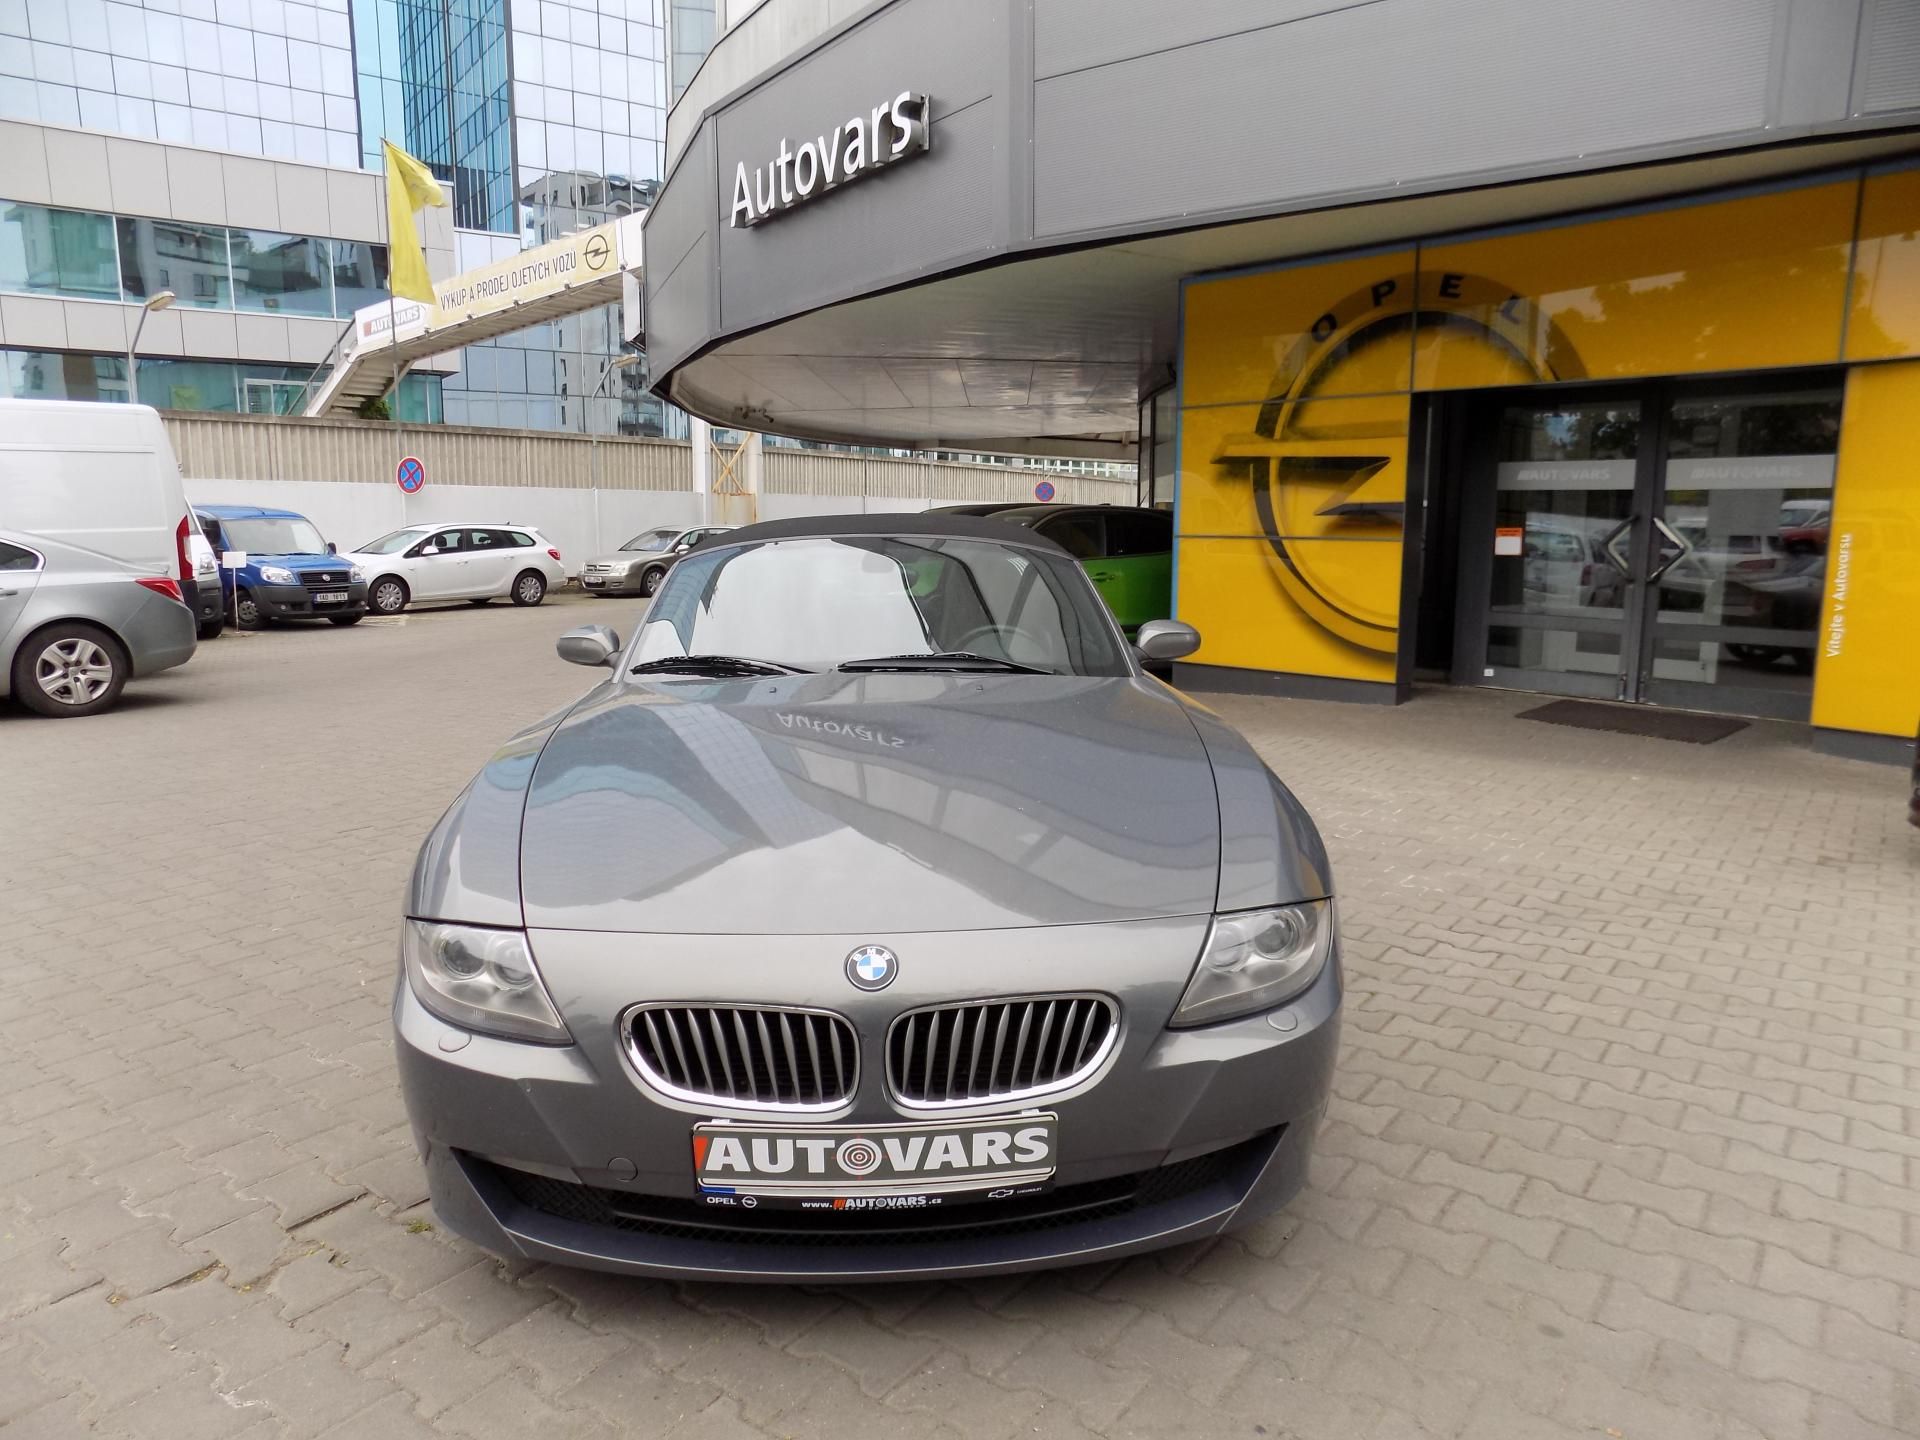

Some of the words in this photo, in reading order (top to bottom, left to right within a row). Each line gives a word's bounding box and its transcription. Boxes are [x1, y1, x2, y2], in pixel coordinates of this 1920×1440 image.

[730, 91, 912, 228] Autovars
[440, 288, 466, 311] VÝKUP
[469, 286, 475, 302] A
[477, 274, 509, 299] PRODEJ
[512, 260, 550, 288] OJETÝCH
[1311, 273, 1521, 342] OPEL
[1832, 533, 1852, 601] Autovarsu
[853, 947, 892, 962] BMW
[705, 1127, 1049, 1175] AUTOVARS
[706, 1196, 737, 1205] OPEL
